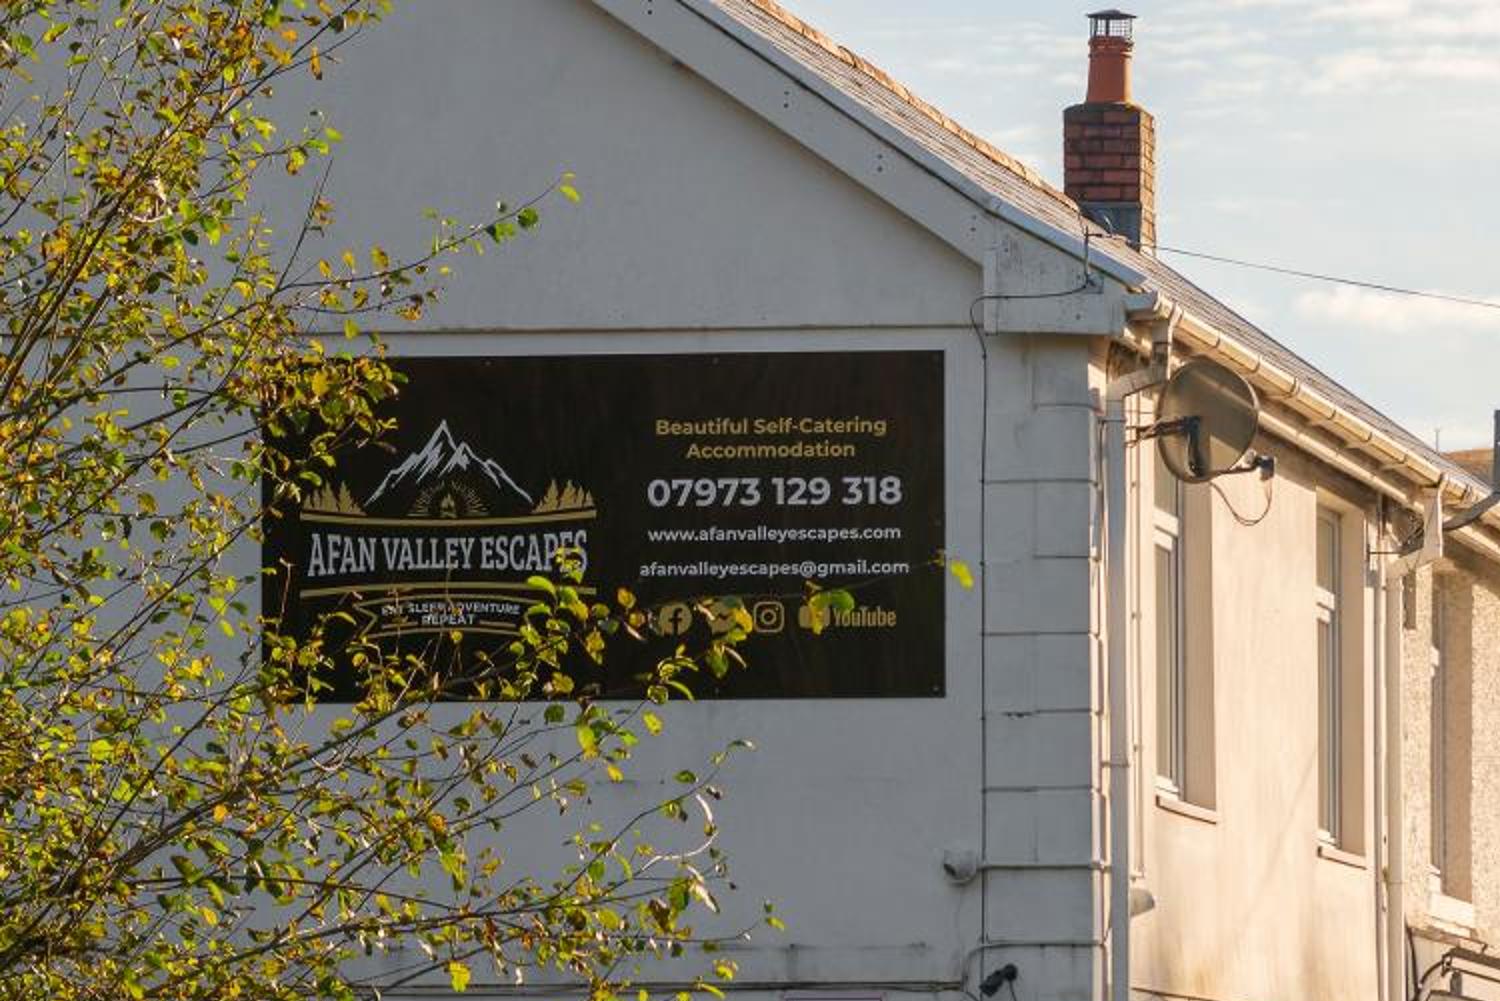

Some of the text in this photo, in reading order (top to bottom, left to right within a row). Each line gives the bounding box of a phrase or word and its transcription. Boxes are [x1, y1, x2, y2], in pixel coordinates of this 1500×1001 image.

[655, 416, 888, 437] Beautiful Self-Catering
[686, 440, 856, 459] Accommodation
[647, 475, 903, 507] 07973 129 318
[648, 525, 902, 544] www.afanvalleyescapes.com
[307, 532, 377, 577] AFAN
[381, 536, 477, 571] VALLEY
[640, 559, 910, 579] afanvalleyescapes@gmail.com
[833, 605, 897, 628] YouTube
